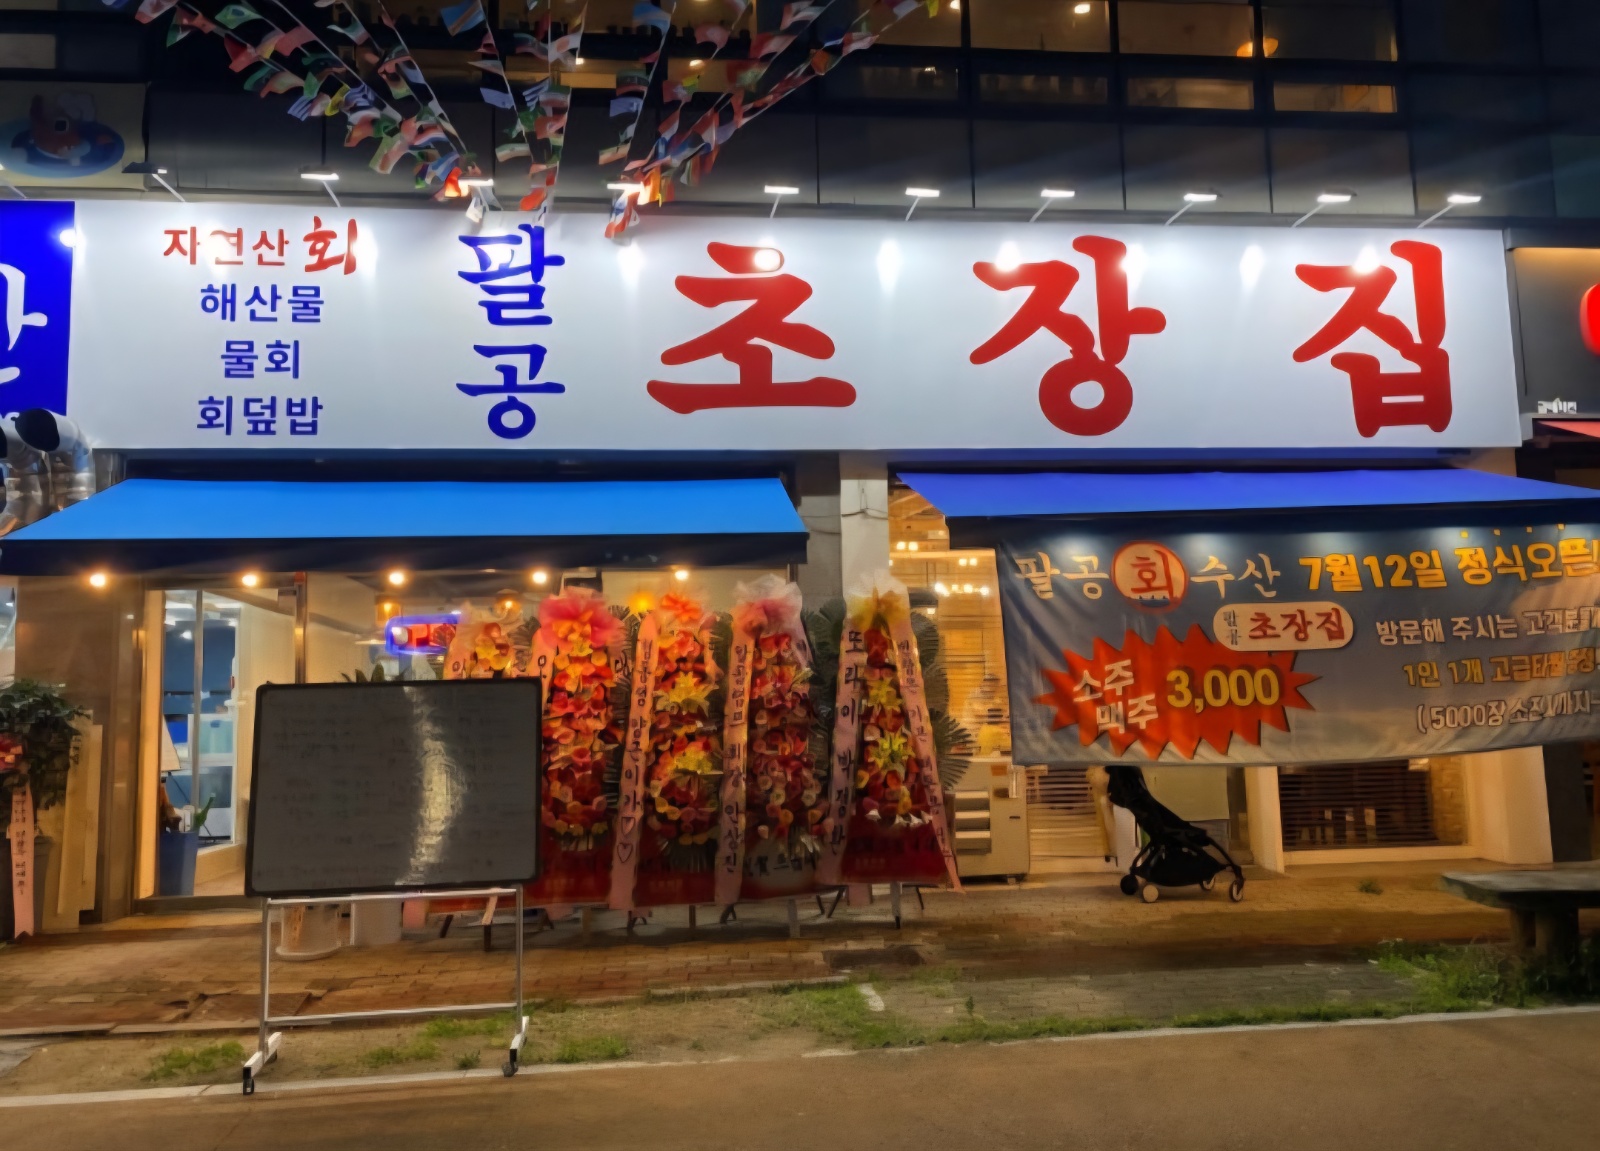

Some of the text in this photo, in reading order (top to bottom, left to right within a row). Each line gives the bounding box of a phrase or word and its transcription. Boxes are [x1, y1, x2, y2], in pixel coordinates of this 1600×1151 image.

[163, 216, 358, 275] 자연산 회
[200, 284, 325, 323] 해산물
[456, 224, 566, 439] 팔공
[647, 236, 1452, 437] 초장집
[220, 339, 300, 379] 물회
[197, 395, 324, 436] 회덮밥
[1016, 551, 1110, 600] 팔공
[1131, 549, 1175, 600] 회
[1190, 553, 1281, 599] 수산
[1249, 607, 1346, 642] 초장집
[1376, 617, 1446, 646] 방문해
[1450, 614, 1518, 641] 주시는
[1073, 659, 1135, 702] 소주
[1166, 667, 1280, 713] 3,000
[1403, 660, 1442, 689] 1인
[1447, 657, 1485, 685] 1개
[1096, 694, 1159, 734] 맥주
